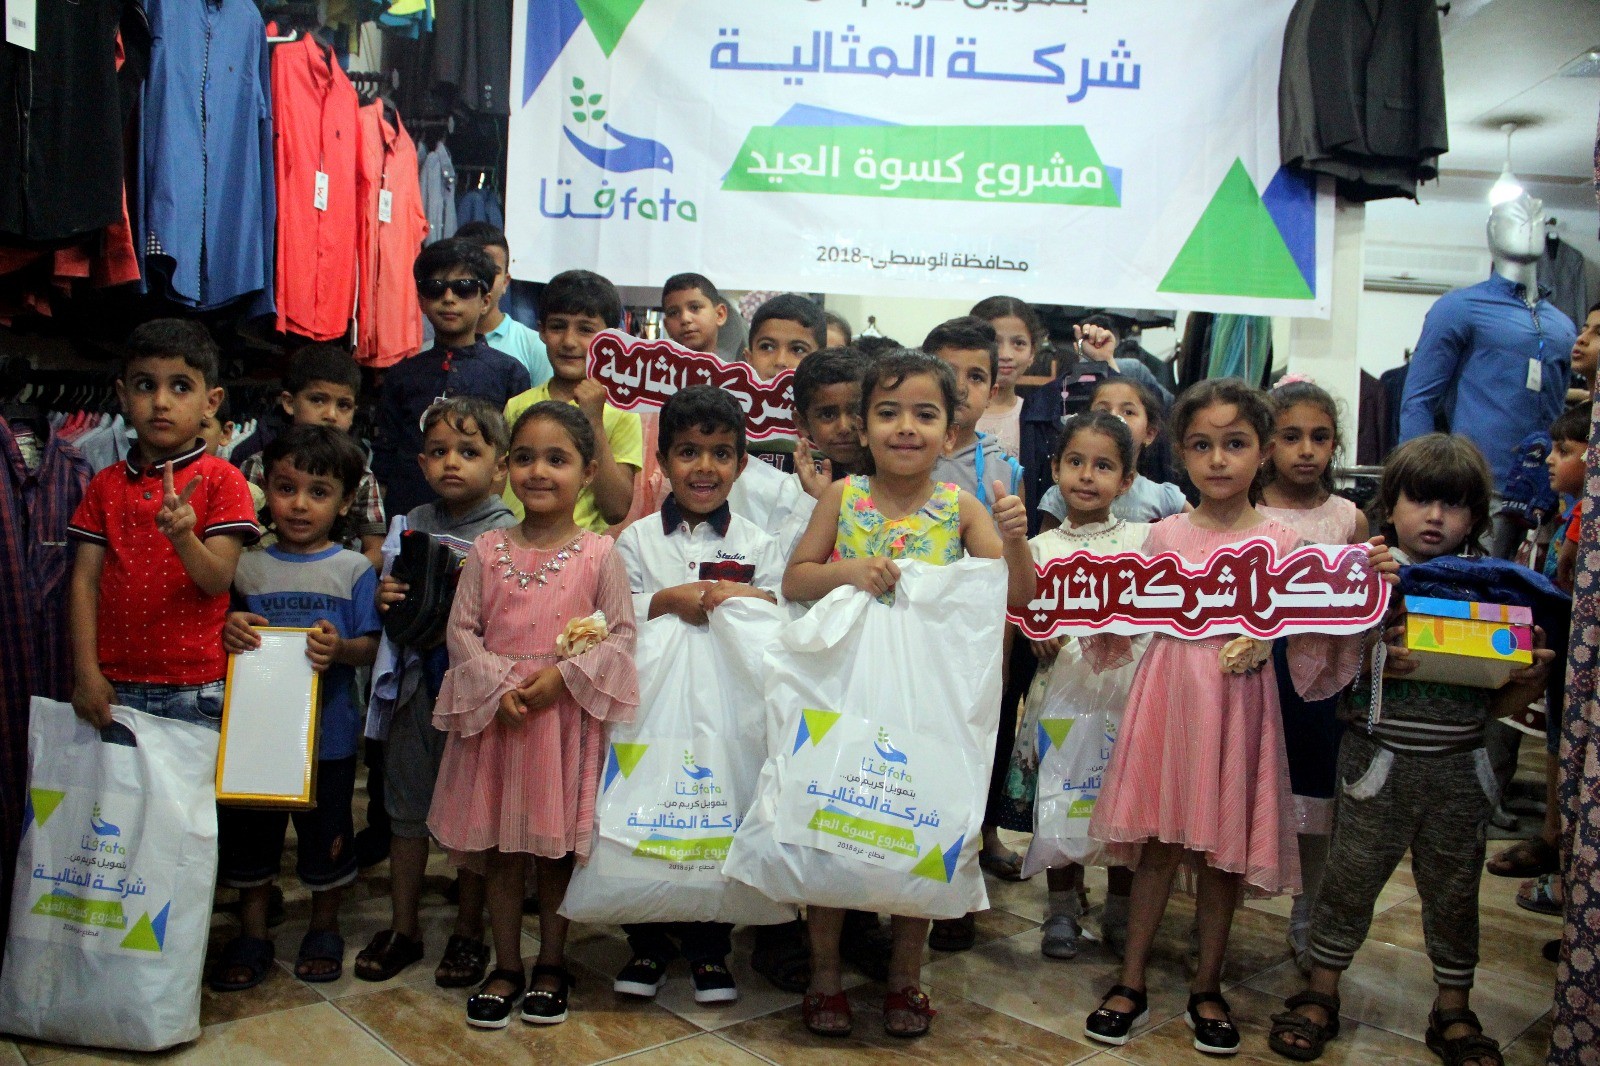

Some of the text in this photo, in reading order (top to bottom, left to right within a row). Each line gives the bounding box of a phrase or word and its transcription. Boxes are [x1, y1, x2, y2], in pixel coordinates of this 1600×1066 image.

[709, 24, 1141, 104] شركة المثالية
[747, 145, 1103, 198] مشروع كسوة العيد
[619, 186, 698, 222] fata
[951, 251, 1029, 273] محافظة
[715, 549, 746, 561] Studio
[1028, 566, 1109, 623] المثالي
[1118, 564, 1238, 620] شركة
[860, 777, 884, 790] كريم
[887, 766, 912, 783] fata
[885, 783, 916, 800] بتمويل
[679, 800, 700, 810] كريم
[806, 780, 940, 828] شركة المثالية
[627, 811, 698, 832] المثالية
[841, 823, 876, 840] كسوة
[99, 841, 126, 855] fata
[876, 835, 915, 851] مشروع
[32, 863, 147, 899] شركة المثالية
